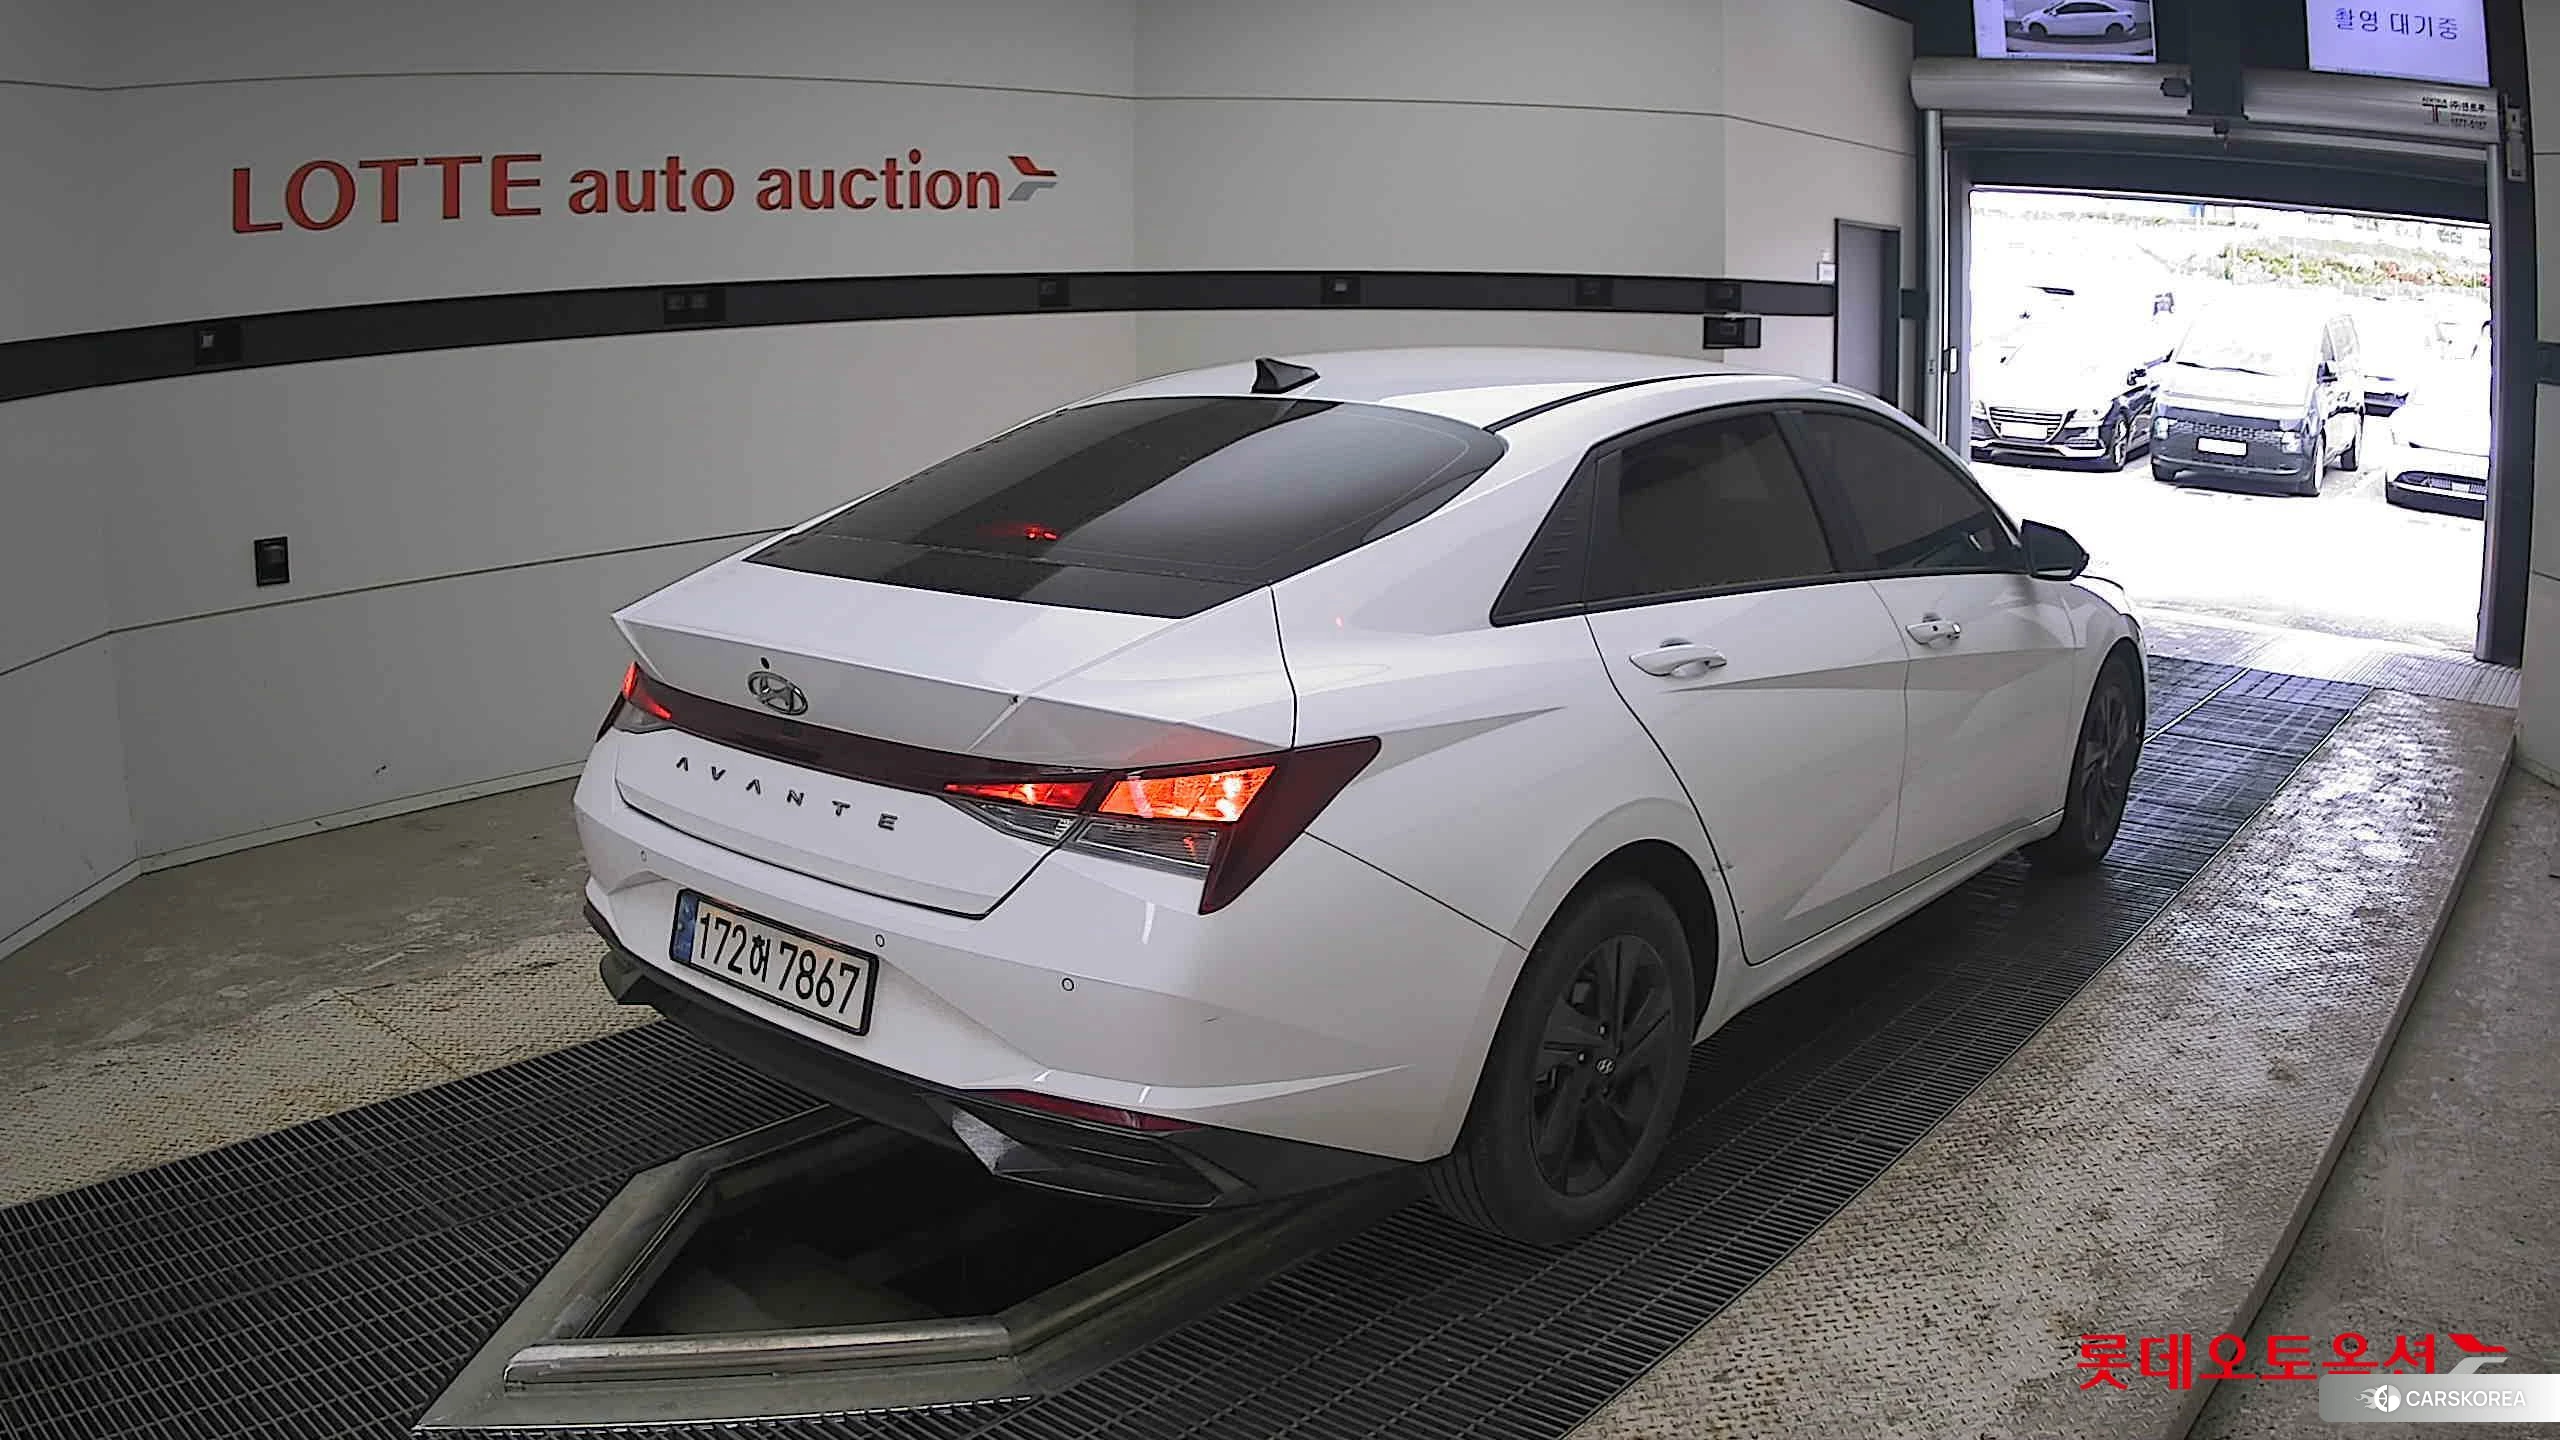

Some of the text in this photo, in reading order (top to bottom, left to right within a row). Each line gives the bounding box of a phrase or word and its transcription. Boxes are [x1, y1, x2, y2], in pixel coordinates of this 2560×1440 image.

[2335, 8, 2458, 40] 촬영 대기중
[231, 149, 1001, 233] LOTTE auto auction
[676, 756, 899, 831] AVANTE
